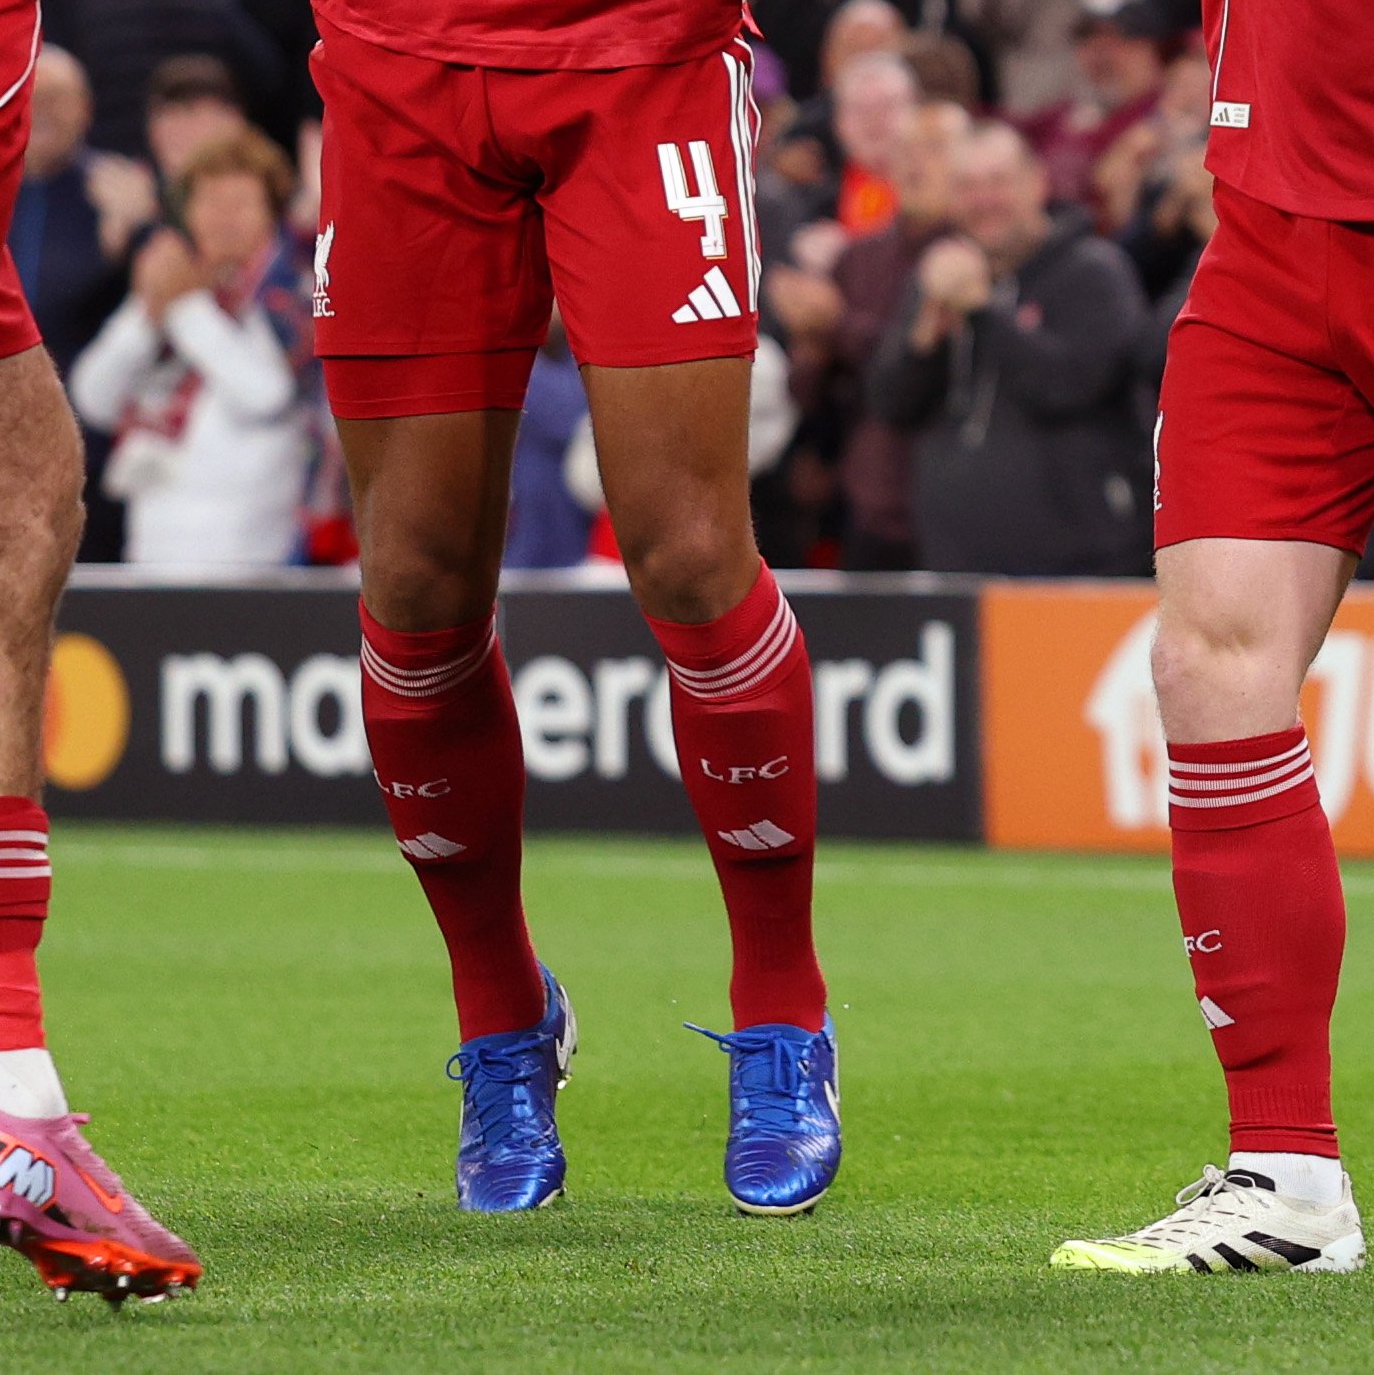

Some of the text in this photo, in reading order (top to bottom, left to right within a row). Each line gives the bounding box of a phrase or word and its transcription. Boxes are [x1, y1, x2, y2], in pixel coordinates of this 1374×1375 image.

[657, 140, 728, 260] 4
[700, 755, 788, 785] LFC
[1183, 929, 1223, 958] FC
